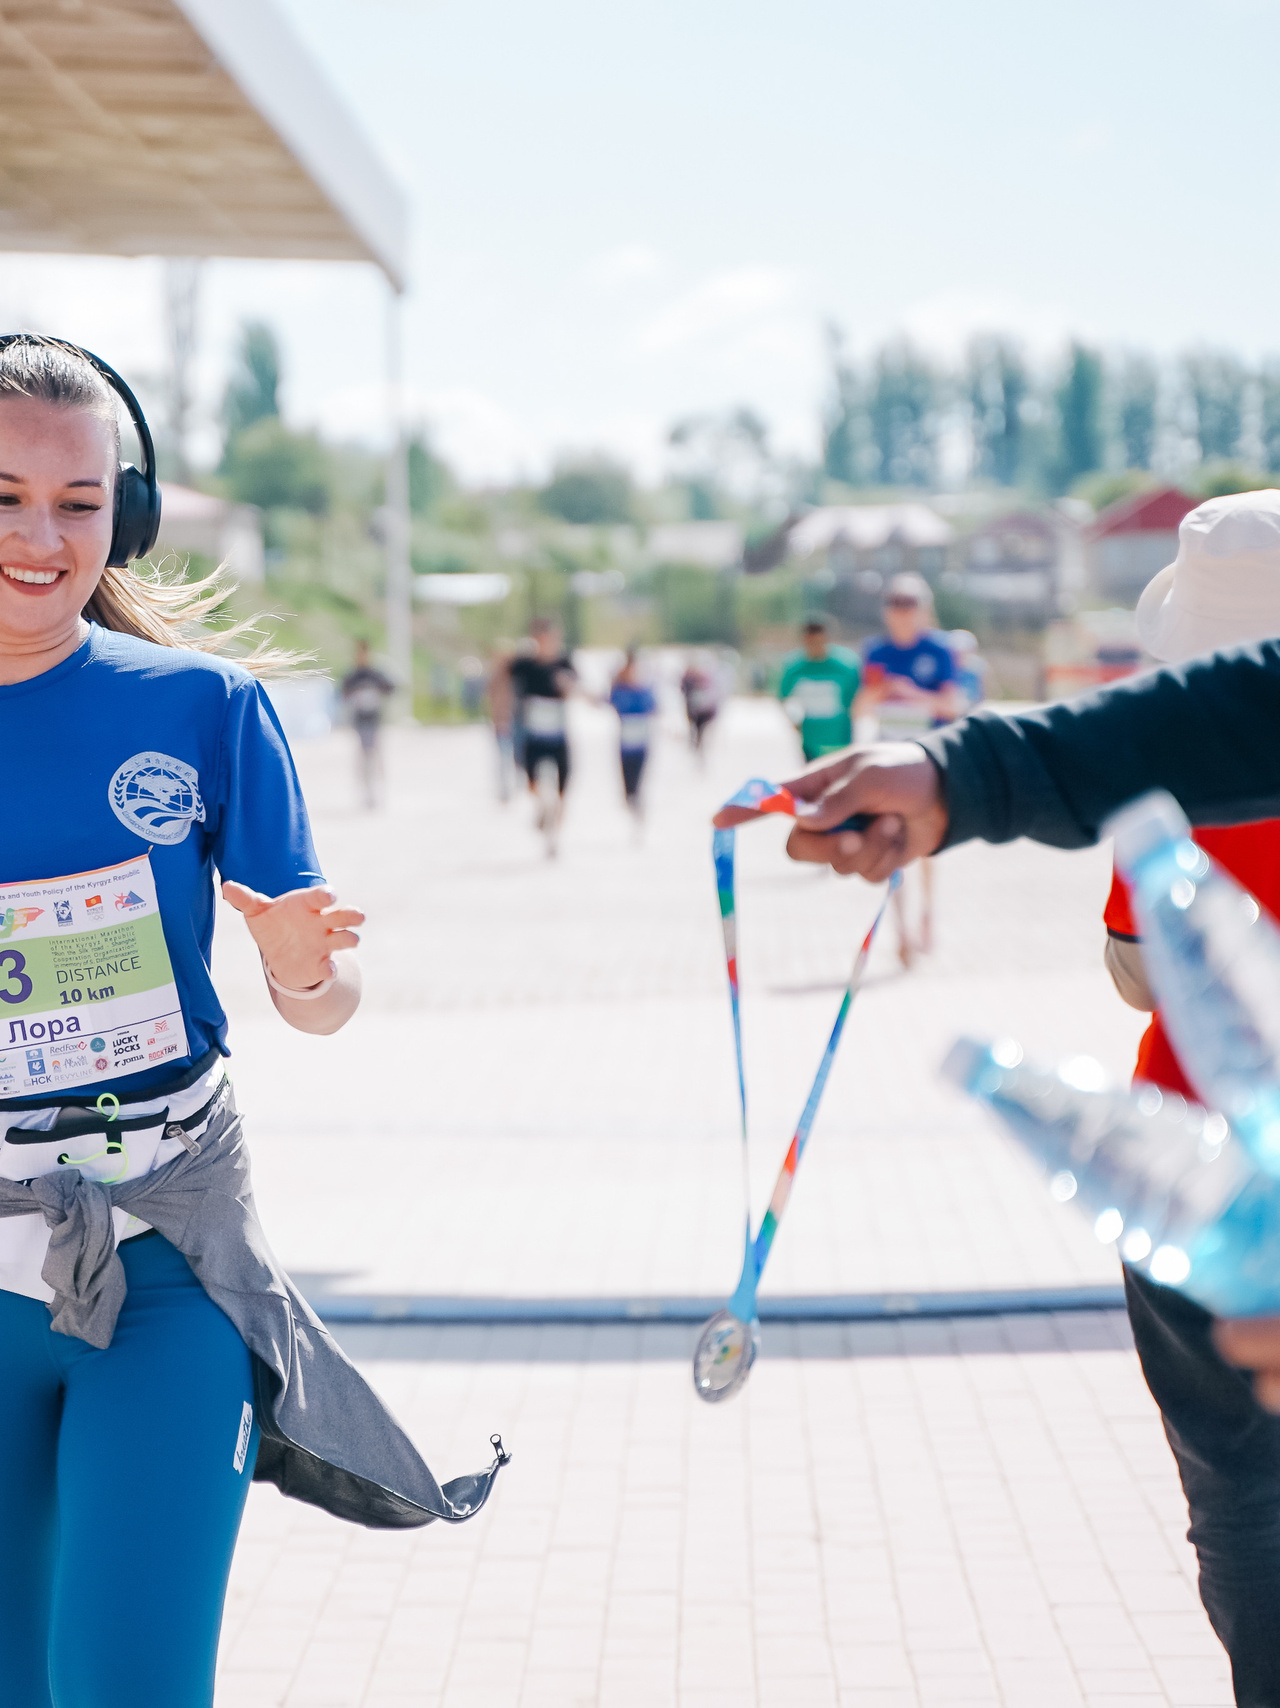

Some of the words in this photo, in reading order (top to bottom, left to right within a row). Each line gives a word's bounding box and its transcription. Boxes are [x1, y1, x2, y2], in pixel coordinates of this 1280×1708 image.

[22, 888, 41, 898] Youth
[42, 886, 64, 896] Policy
[74, 882, 86, 891] the
[87, 878, 111, 889] Kyrgyz
[113, 869, 141, 882] Republic
[49, 934, 97, 945] International
[100, 926, 134, 937] Marathon
[76, 941, 100, 949] Kyrgyz
[105, 931, 135, 943] Republic
[111, 937, 136, 947] Shanghai
[53, 954, 91, 963] Cooperation
[61, 961, 82, 969] memory
[56, 955, 142, 984] DISTANCE
[60, 988, 82, 1005] 10
[87, 985, 115, 1001] km
[9, 1015, 82, 1043] Лора
[112, 1034, 139, 1048] LUCKY
[113, 1043, 141, 1057] SOCKS
[55, 1069, 93, 1081] REVYLINE
